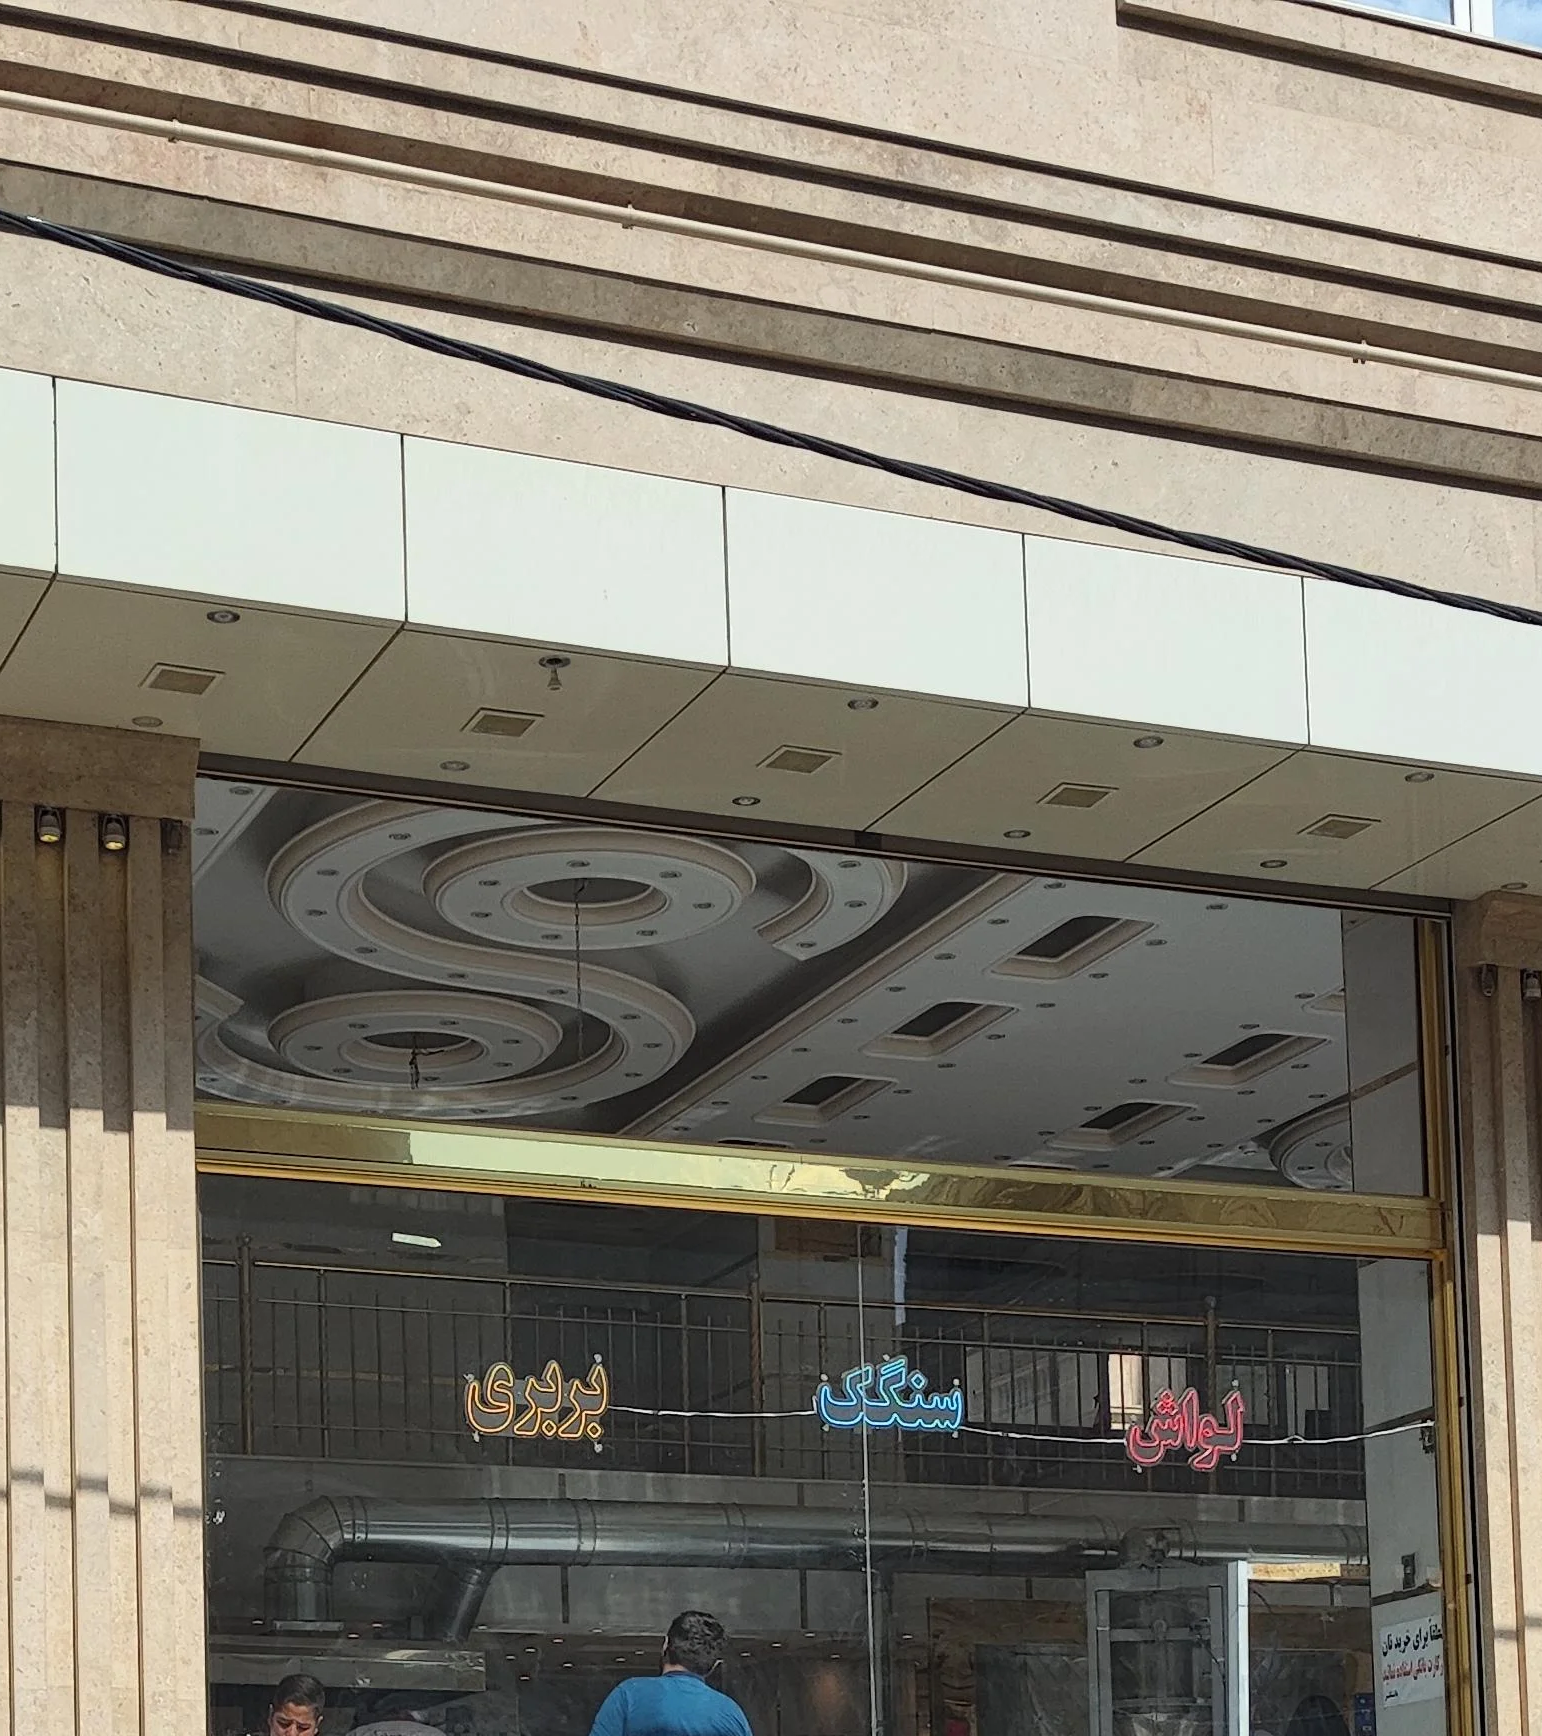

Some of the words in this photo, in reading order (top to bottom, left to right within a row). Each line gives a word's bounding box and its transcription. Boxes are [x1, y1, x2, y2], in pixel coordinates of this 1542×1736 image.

[466, 1362, 608, 1438] بربری
[819, 1357, 963, 1430] سنگک
[1128, 1389, 1244, 1471] لواش
[1382, 1633, 1393, 1657] نان
[1394, 1630, 1412, 1654] خرید
[1412, 1627, 1429, 1651] برای
